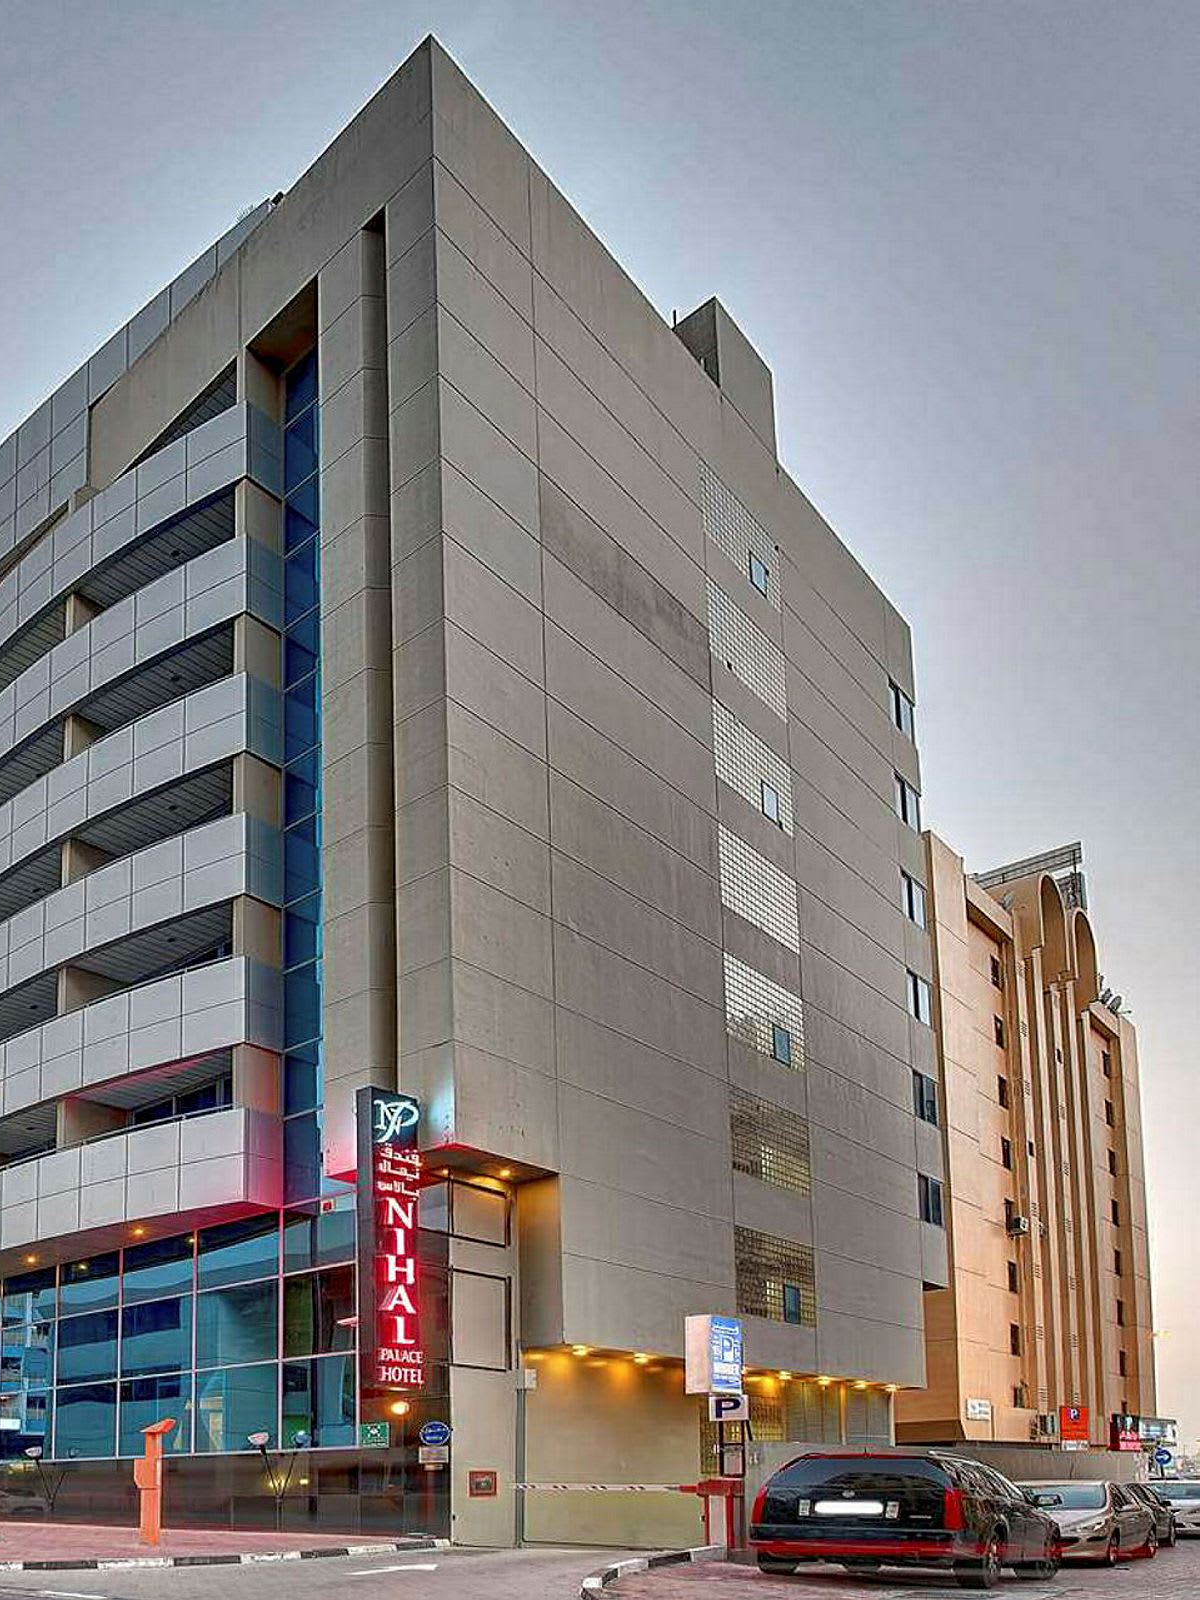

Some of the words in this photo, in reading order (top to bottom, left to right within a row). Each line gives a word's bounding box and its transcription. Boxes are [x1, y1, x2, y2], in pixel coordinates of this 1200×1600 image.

[380, 1142, 422, 1168] فندق
[385, 1197, 417, 1345] NIHAL
[381, 1347, 424, 1364] PALACE
[381, 1365, 424, 1384] HOTEL
[715, 1398, 741, 1418] P
